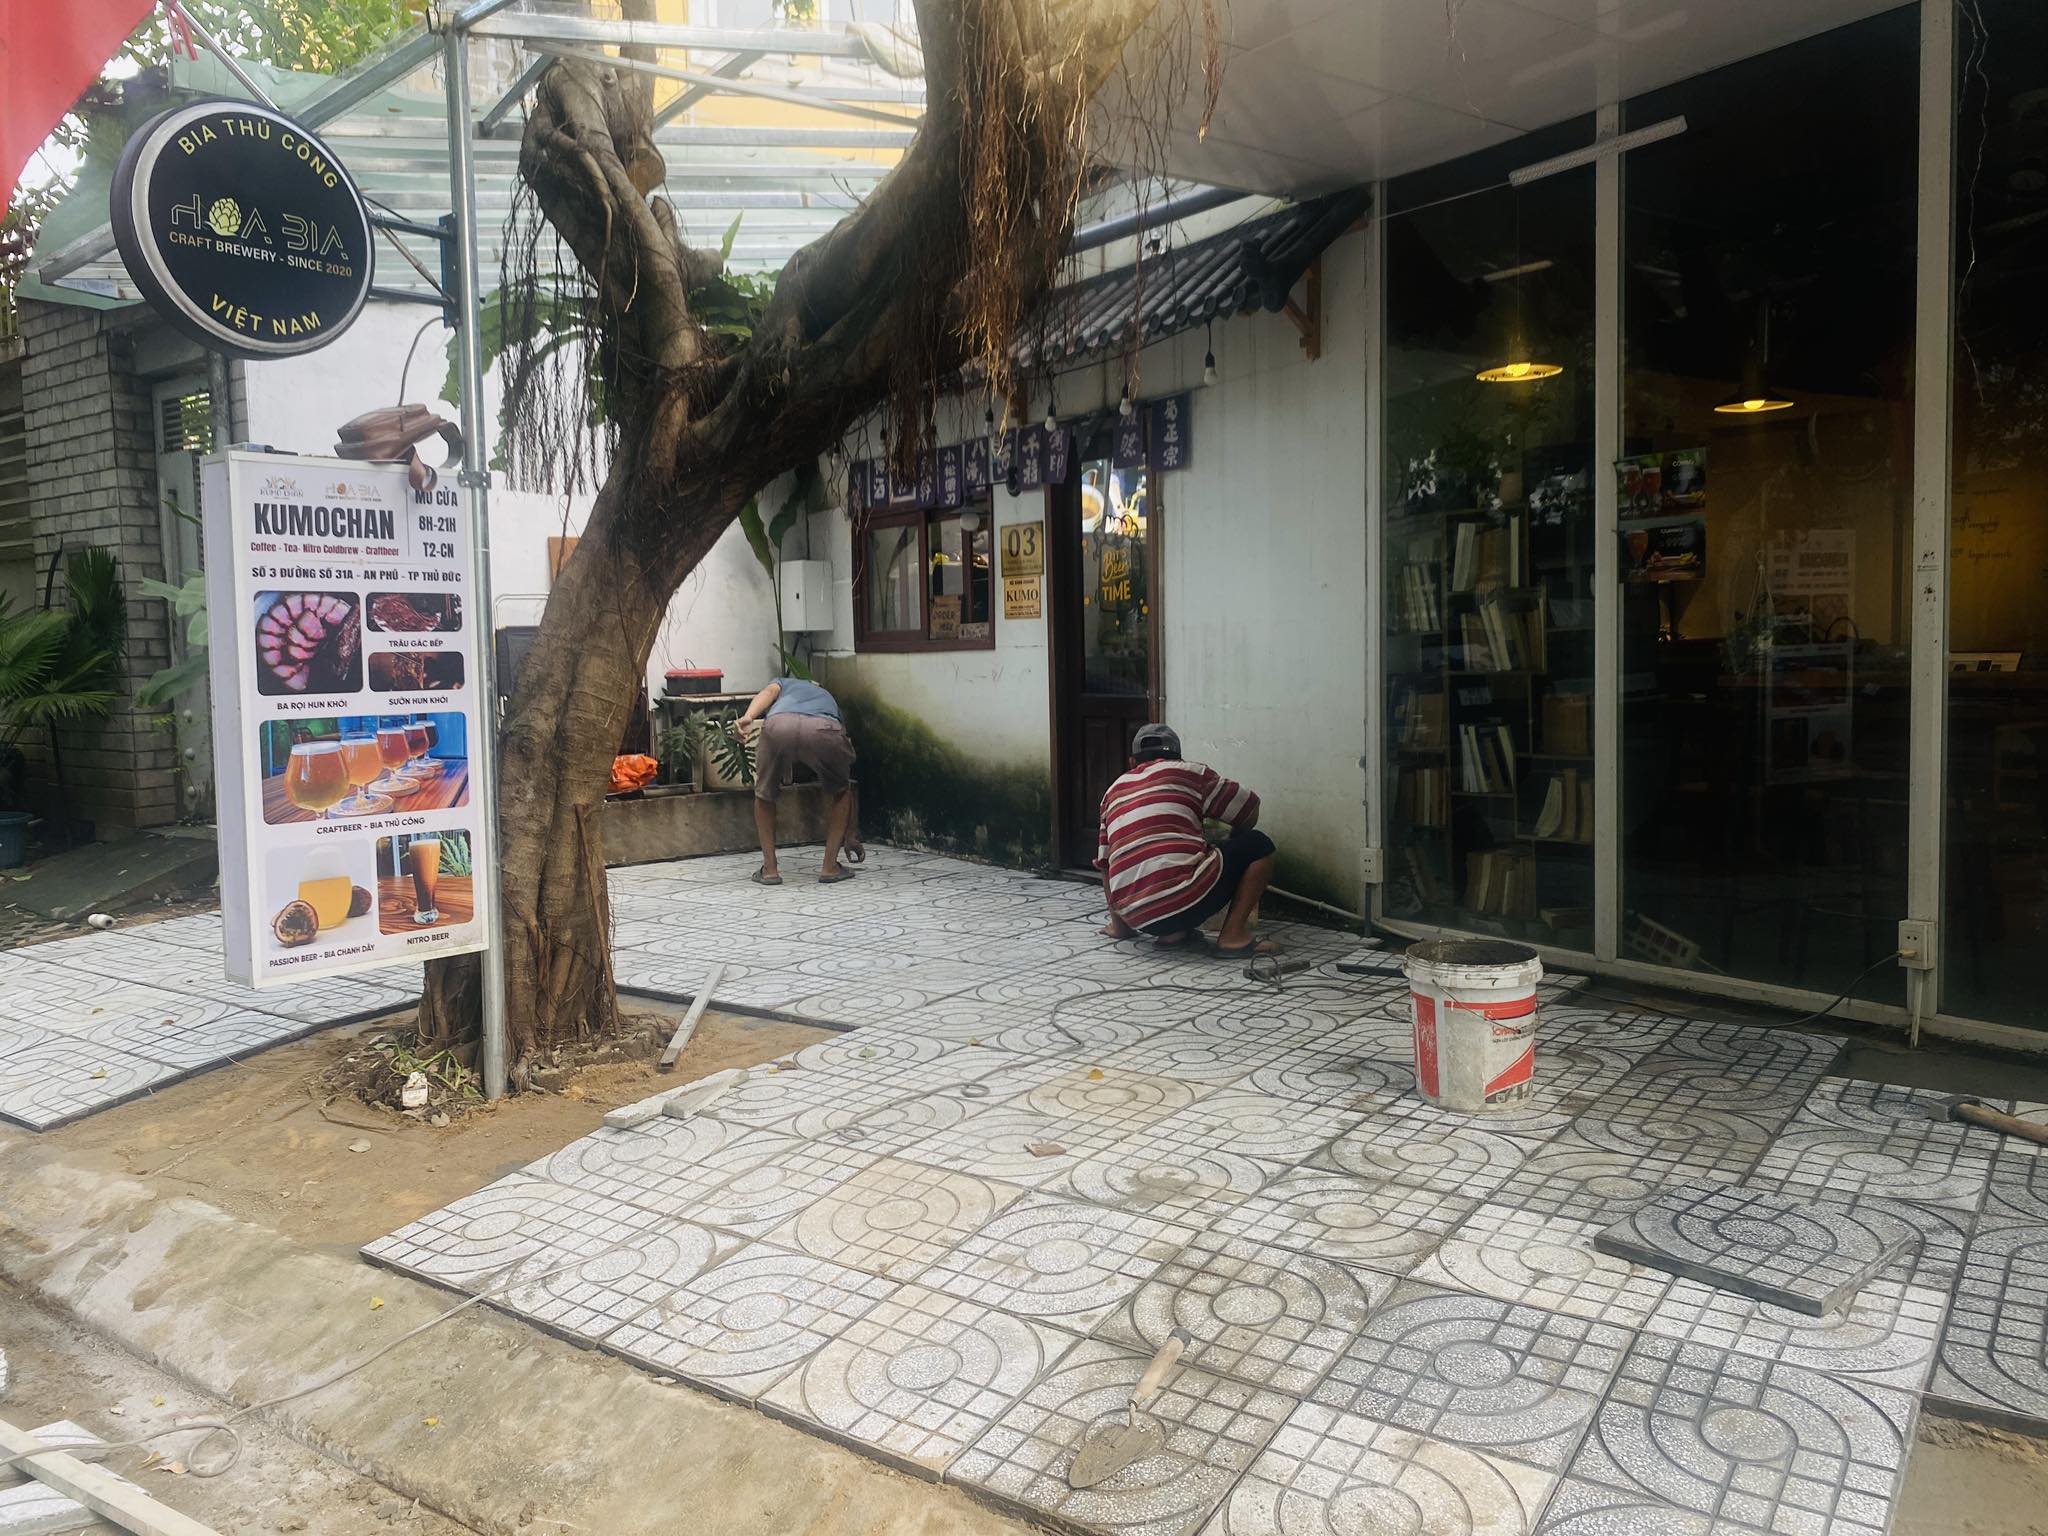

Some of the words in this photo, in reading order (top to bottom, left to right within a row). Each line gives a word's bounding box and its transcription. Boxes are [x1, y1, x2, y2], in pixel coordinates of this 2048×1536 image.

[177, 124, 217, 156] BIA
[222, 118, 270, 139] THỦ
[281, 133, 338, 189] CÔNG
[169, 231, 212, 250] CRAFT
[216, 239, 277, 263] BREWERY
[287, 255, 323, 272] SINCE
[326, 263, 353, 277] 2020
[211, 293, 263, 332] VIỆT
[273, 311, 321, 336] NAM
[436, 486, 458, 507] CỬA
[254, 502, 395, 540] KUMOCHAN
[418, 515, 456, 533] 8H-21H
[250, 542, 276, 552] Coffee
[303, 543, 321, 553] Nitro
[323, 544, 359, 555] Coldbrew
[365, 546, 399, 556] Craftbeer
[422, 541, 454, 558] T2-CN
[1007, 526, 1036, 558] 03
[251, 564, 267, 578] SỐ
[269, 567, 277, 578] 3
[280, 565, 316, 579] ĐƯỜNG
[319, 566, 333, 579] SỐ
[335, 569, 354, 579] 31A
[363, 570, 377, 580] AN
[379, 568, 399, 580] PHÚ
[408, 571, 420, 581] TP
[422, 569, 440, 581] THỦ
[442, 569, 462, 582] ĐỨC
[1006, 588, 1038, 602] KUMO
[1102, 579, 1132, 601] TIME
[388, 640, 409, 648] TRÂU
[410, 639, 428, 648] GÁC
[277, 702, 289, 711] BA
[308, 701, 326, 709] HUN
[327, 700, 348, 709] KHÓI
[412, 697, 428, 705] HUN
[430, 696, 449, 705] KHÓI
[316, 823, 362, 835] CRAFTBEER
[370, 821, 384, 829] BIA
[384, 818, 400, 828] THỦ
[401, 817, 426, 826] CÔNG
[407, 935, 430, 945] NITRO
[431, 932, 450, 942] BEER
[269, 955, 300, 968] PASSION
[301, 953, 318, 962] BEER
[324, 950, 336, 959] BIA
[336, 946, 361, 957] CHANH
